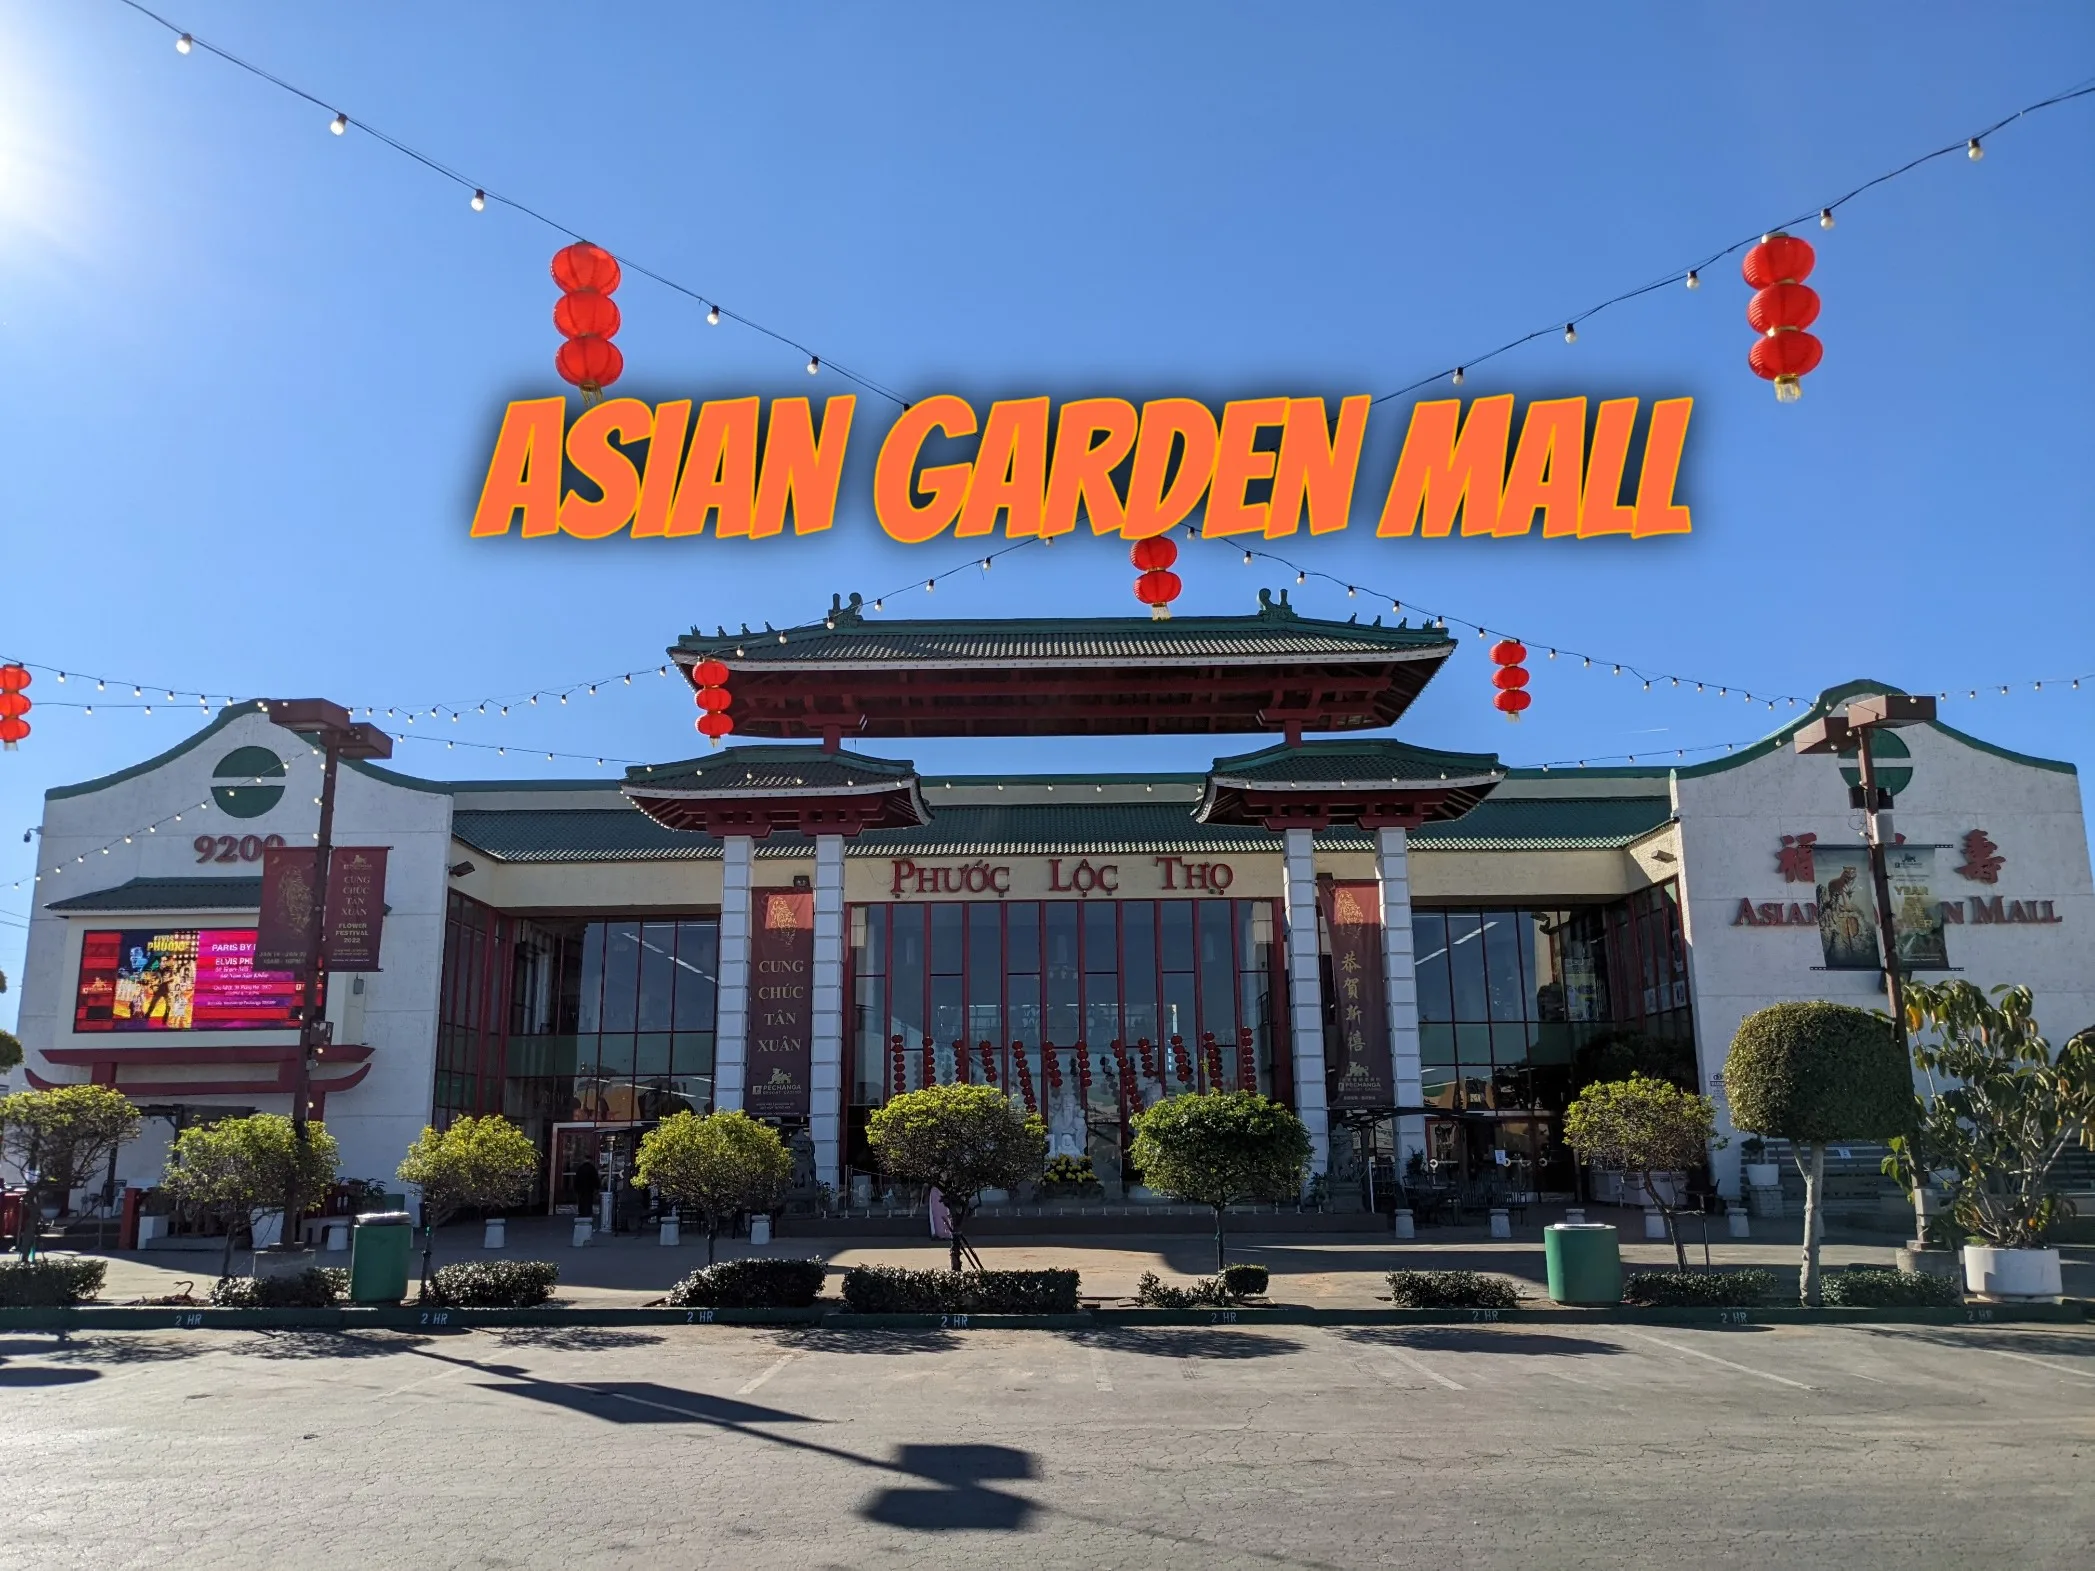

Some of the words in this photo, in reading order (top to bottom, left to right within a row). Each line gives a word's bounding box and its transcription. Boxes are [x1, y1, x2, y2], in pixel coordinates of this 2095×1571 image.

[1969, 896, 2063, 924] MALL
[758, 960, 804, 973] CUNG
[758, 983, 804, 1000] CHÚC
[764, 1009, 797, 1026] TÂN
[757, 1036, 801, 1052] XUÂN
[175, 1315, 182, 1326] 2
[187, 1314, 202, 1326] HR
[421, 1313, 428, 1324] 2
[433, 1313, 448, 1325] HR
[687, 1311, 694, 1323] 2
[699, 1311, 714, 1323] HR
[940, 1315, 948, 1327] 2
[953, 1315, 968, 1327] HR
[1211, 1312, 1218, 1323] 2
[1223, 1312, 1237, 1323] HR
[1472, 1310, 1479, 1321] 2
[1484, 1310, 1499, 1321] HR
[1720, 1312, 1727, 1324] 2
[1732, 1311, 1747, 1324] HR
[1967, 1310, 1974, 1321] 2
[1978, 1310, 1993, 1321] HR
